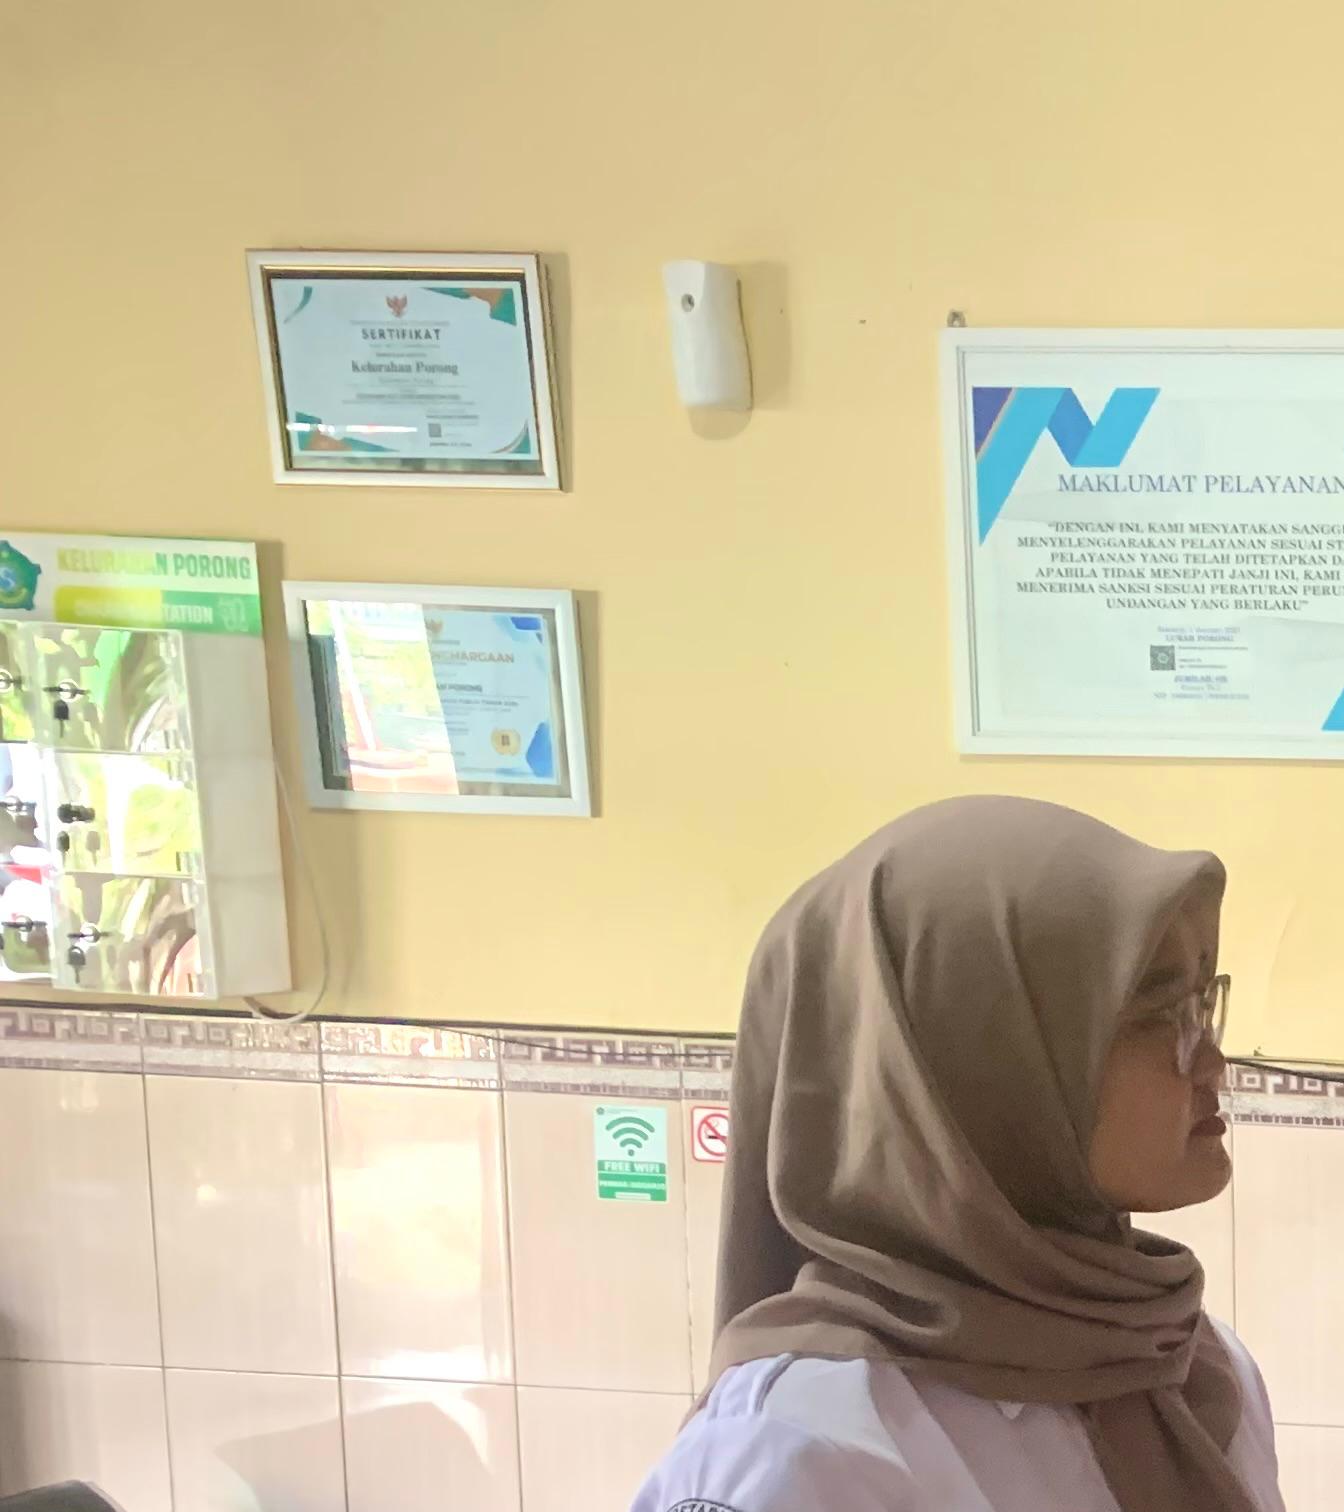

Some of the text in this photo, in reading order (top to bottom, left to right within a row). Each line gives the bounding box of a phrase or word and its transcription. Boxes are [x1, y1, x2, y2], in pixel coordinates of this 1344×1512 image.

[361, 327, 441, 341] SERTIFIKAT
[351, 360, 459, 376] Kelurahan Porong
[1057, 473, 1197, 493] MAKLUMAT
[1148, 522, 1184, 534] KAMI
[1188, 522, 1289, 535] MENYATAKAN
[1016, 536, 1177, 549] MENYELENGGARAKAN
[1180, 538, 1267, 550] PELAYANAN
[1270, 539, 1323, 551] SESUAI
[57, 548, 251, 580] KELURN PORONG
[1050, 551, 1136, 564] PELAYANAN
[1140, 552, 1179, 564] YANG
[1183, 553, 1231, 565] TELAH
[1235, 554, 1328, 566] DITETAPKAN
[1035, 566, 1098, 579] APABILA
[1101, 567, 1146, 579] TIDAK
[1149, 568, 1225, 580] MENEPATI
[1228, 568, 1270, 581] JANJI
[1303, 569, 1341, 581] KAMI
[1016, 582, 1096, 594] MENERIMA
[1099, 582, 1150, 594] SANKSI
[1154, 583, 1206, 595] SESUAI
[1210, 584, 1299, 596] PERATURAN
[1106, 598, 1187, 610] UNDANGAN
[1190, 598, 1230, 611] YANG
[158, 603, 214, 625] TATION
[604, 1161, 632, 1172] FREE
